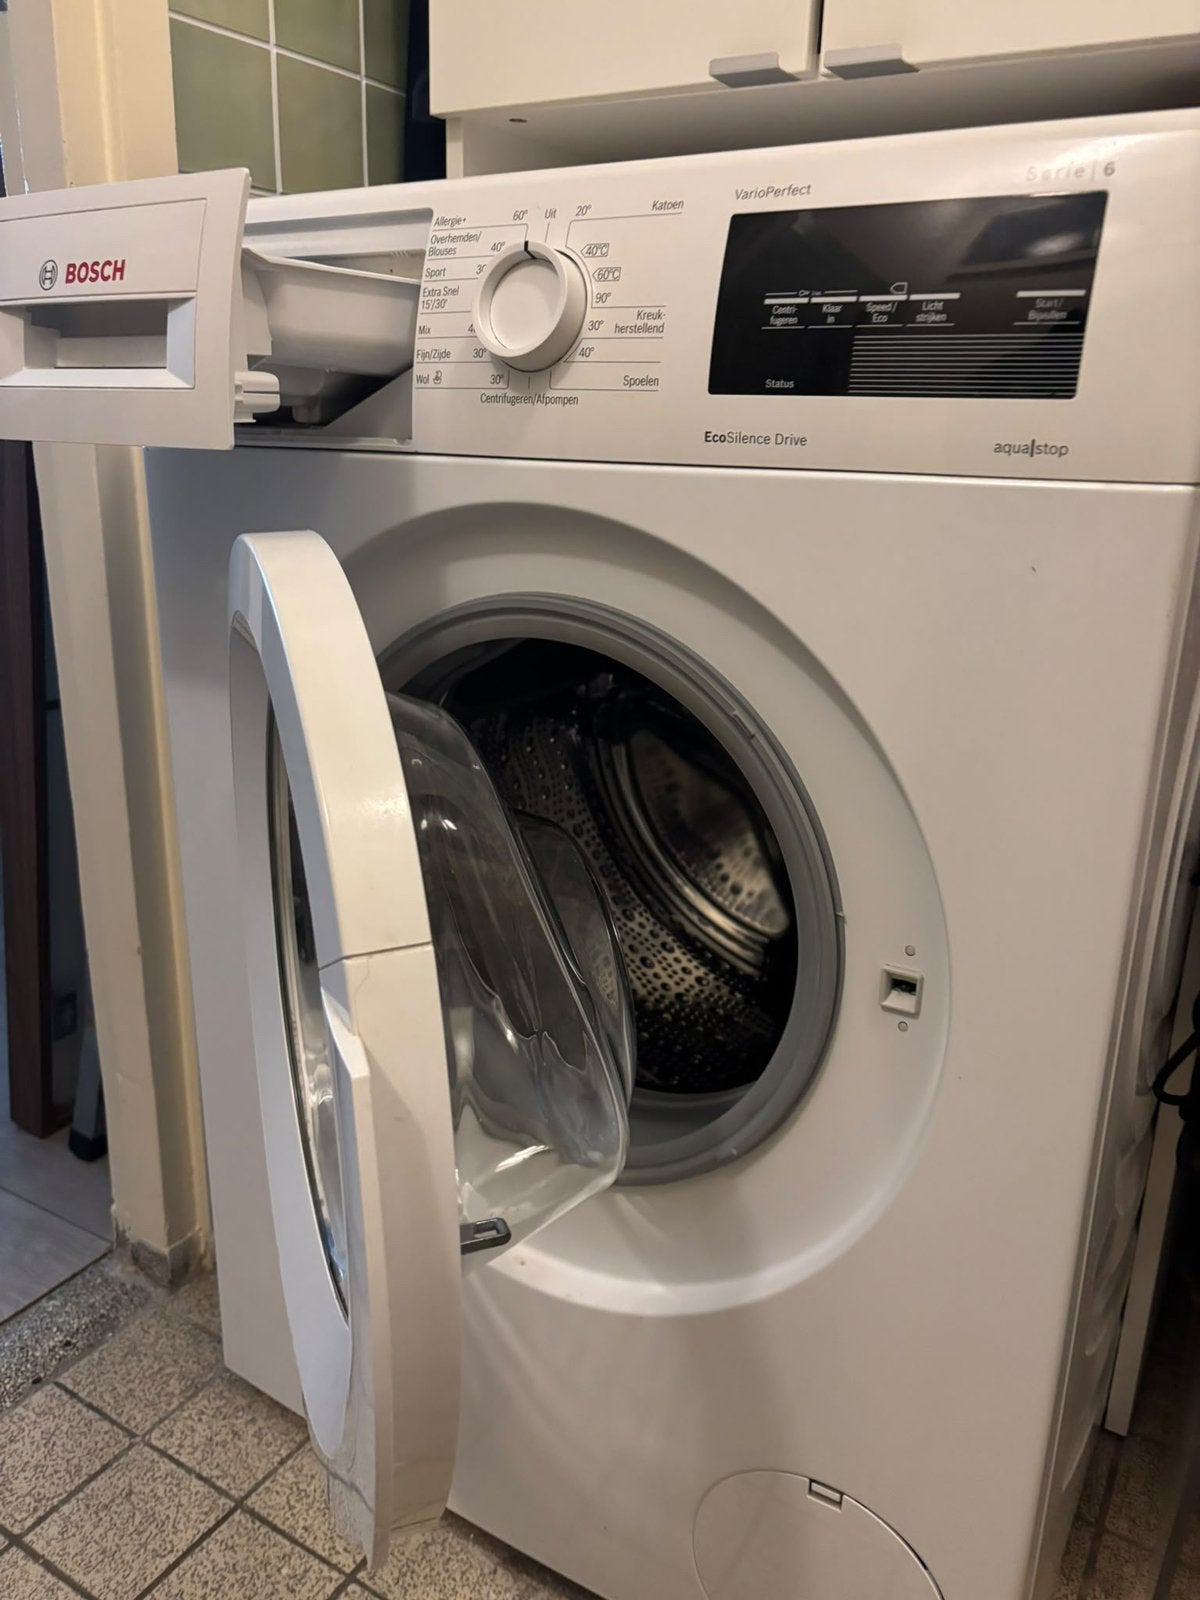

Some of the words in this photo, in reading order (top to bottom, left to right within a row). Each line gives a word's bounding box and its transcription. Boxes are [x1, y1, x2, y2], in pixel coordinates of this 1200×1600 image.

[735, 184, 812, 200] VarioPerfect
[575, 204, 592, 216] 20°
[651, 200, 684, 211] Katoen
[512, 209, 528, 221] 60°
[544, 208, 557, 219] Uit
[433, 215, 466, 227] Allergie+
[430, 231, 482, 244] Overhemden/
[428, 246, 457, 257] Blouses
[490, 241, 506, 252] 40°
[65, 259, 126, 284] BOSCH
[425, 267, 447, 280] Sport
[422, 287, 441, 298] Extra
[442, 286, 460, 297] Snel
[595, 292, 612, 304] 90°
[822, 304, 843, 314] Klaar
[922, 301, 944, 312] Licht
[637, 309, 666, 320] Kreuk-
[872, 313, 889, 324] Eco
[418, 325, 432, 335] Mix
[588, 320, 604, 331] 30°
[614, 322, 665, 334] herstellend
[416, 348, 451, 361] Fijn/Zijde
[473, 348, 487, 359] 30°
[578, 347, 595, 358] 40°
[416, 374, 430, 384] Wol
[490, 374, 504, 385] 30°
[623, 375, 659, 388] Spoelen
[765, 379, 795, 389] Status
[480, 392, 579, 407] Centrifugeren/Afpompen
[704, 431, 771, 446] EcoSilence
[774, 432, 808, 447] Drive
